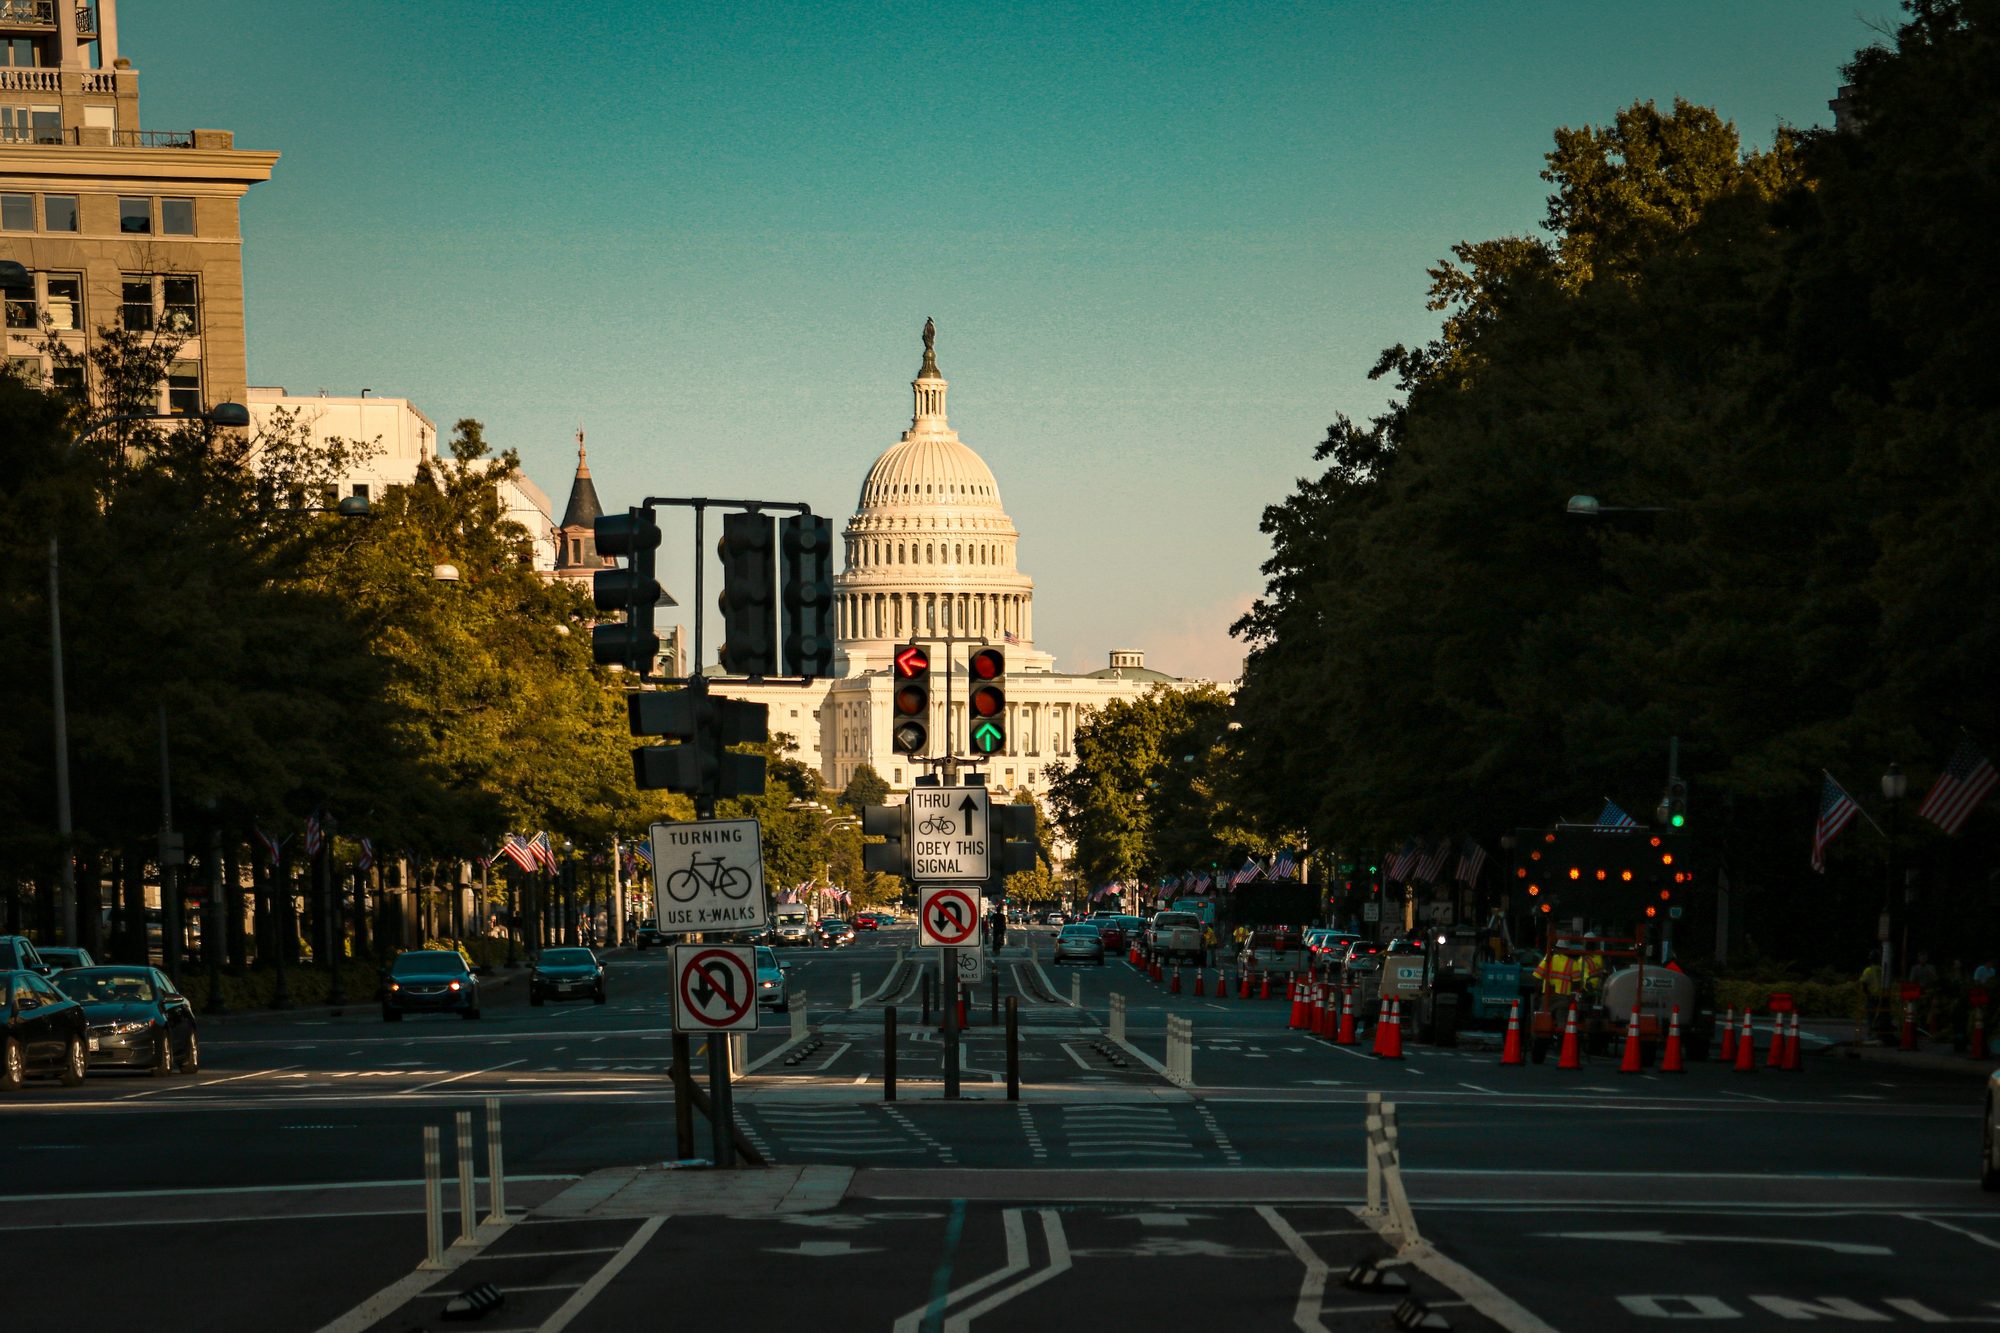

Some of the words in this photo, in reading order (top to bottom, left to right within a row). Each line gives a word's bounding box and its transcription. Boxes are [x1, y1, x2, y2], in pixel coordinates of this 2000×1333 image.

[916, 793, 951, 808] THRU
[669, 828, 743, 846] TURNING
[916, 841, 951, 856] OBEY
[956, 841, 985, 856] THIS
[917, 859, 963, 873] SIGNAL
[668, 909, 693, 924] USE
[698, 906, 756, 923] X-WALKS
[1615, 1293, 2000, 1323] ONL
